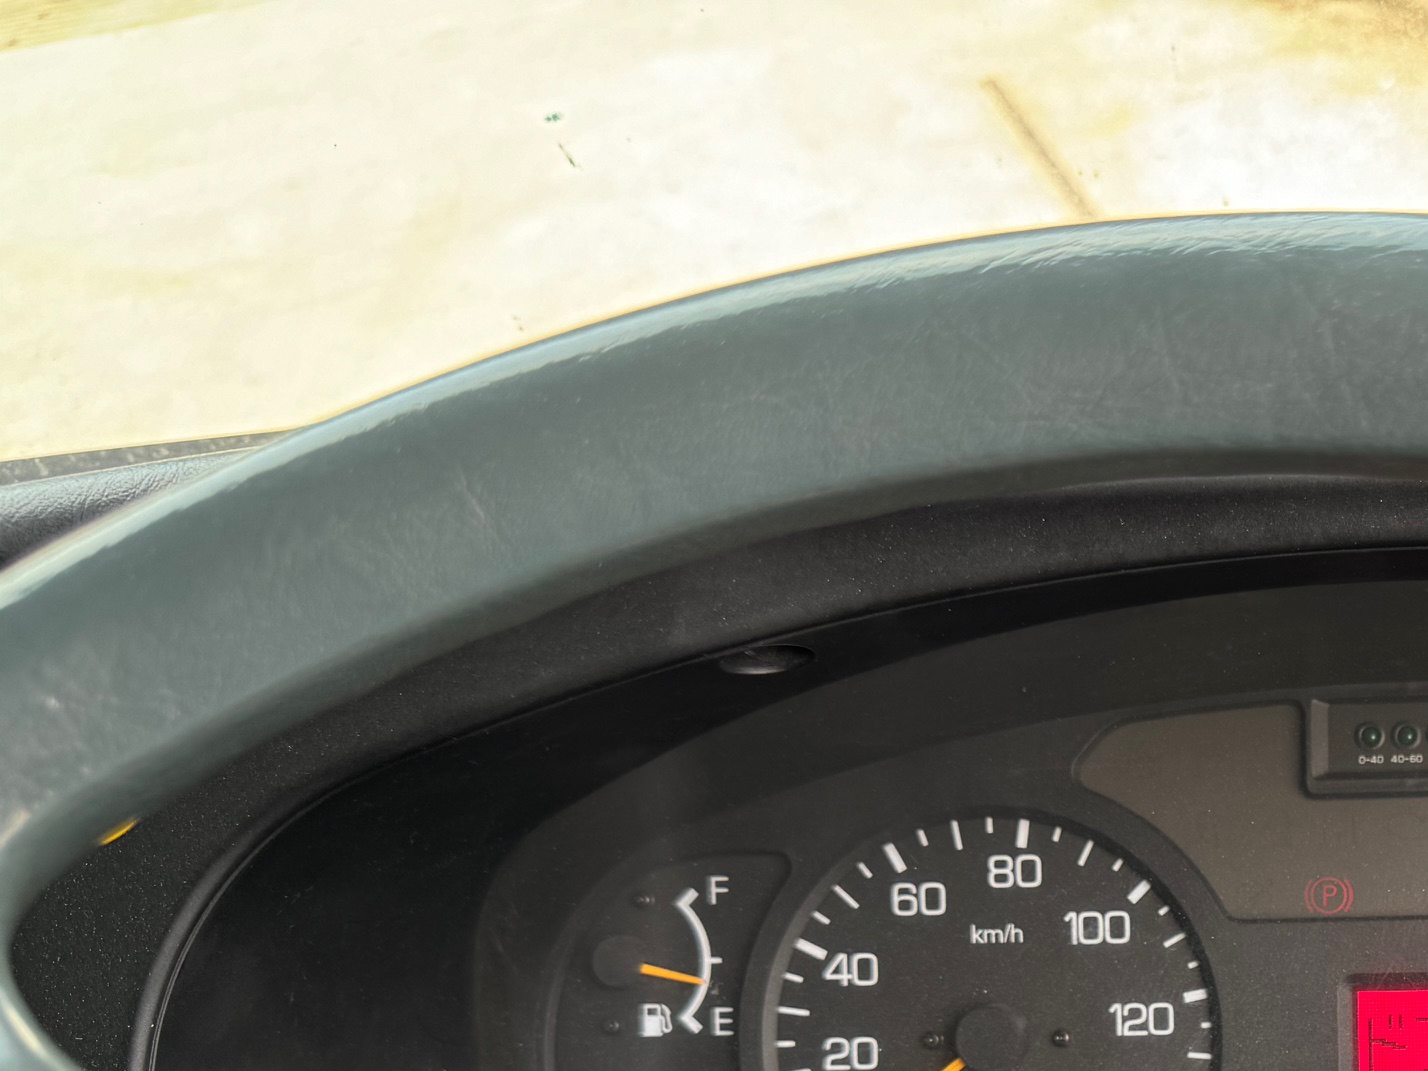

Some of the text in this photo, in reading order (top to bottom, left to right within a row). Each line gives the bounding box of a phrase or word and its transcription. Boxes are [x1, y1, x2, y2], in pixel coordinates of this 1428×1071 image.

[987, 854, 1042, 888] 80
[706, 875, 729, 905] F
[891, 882, 946, 915] 60
[970, 924, 1024, 944] km/h
[1064, 911, 1130, 945] 100
[824, 954, 879, 986] 40
[711, 1007, 735, 1036] E
[1108, 1002, 1175, 1036] 120
[823, 1037, 879, 1071] 20
